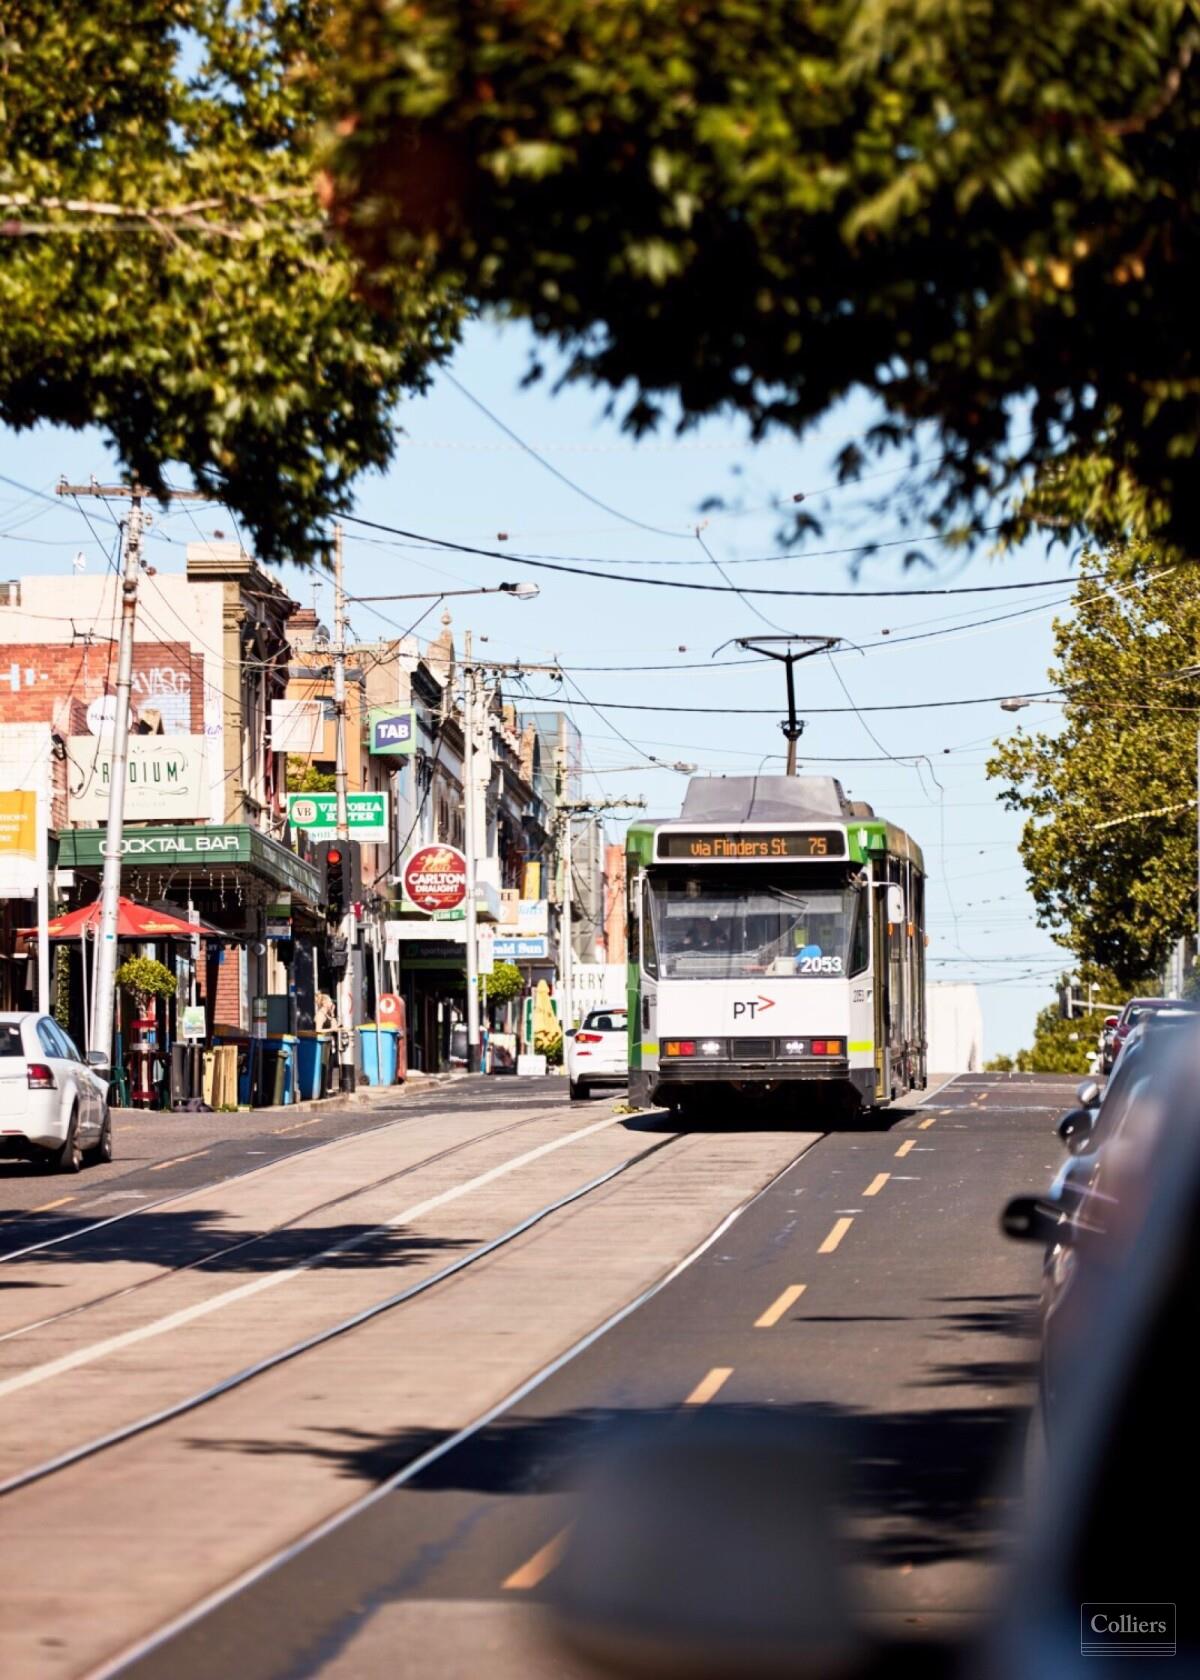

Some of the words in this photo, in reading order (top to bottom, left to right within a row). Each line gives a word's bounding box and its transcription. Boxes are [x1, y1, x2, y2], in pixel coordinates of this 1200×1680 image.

[378, 724, 409, 739] TAB
[102, 761, 178, 783] RDIUM
[297, 807, 312, 817] VB
[318, 802, 382, 812] VIORIA
[326, 812, 375, 822] BTER
[195, 836, 239, 850] BAR
[690, 839, 711, 856] via
[714, 839, 769, 855] Flinders
[771, 838, 788, 855] St
[808, 837, 827, 855] 75
[408, 872, 466, 886] CARLTON
[415, 885, 460, 893] DRAUGHT
[800, 956, 842, 973] 2053
